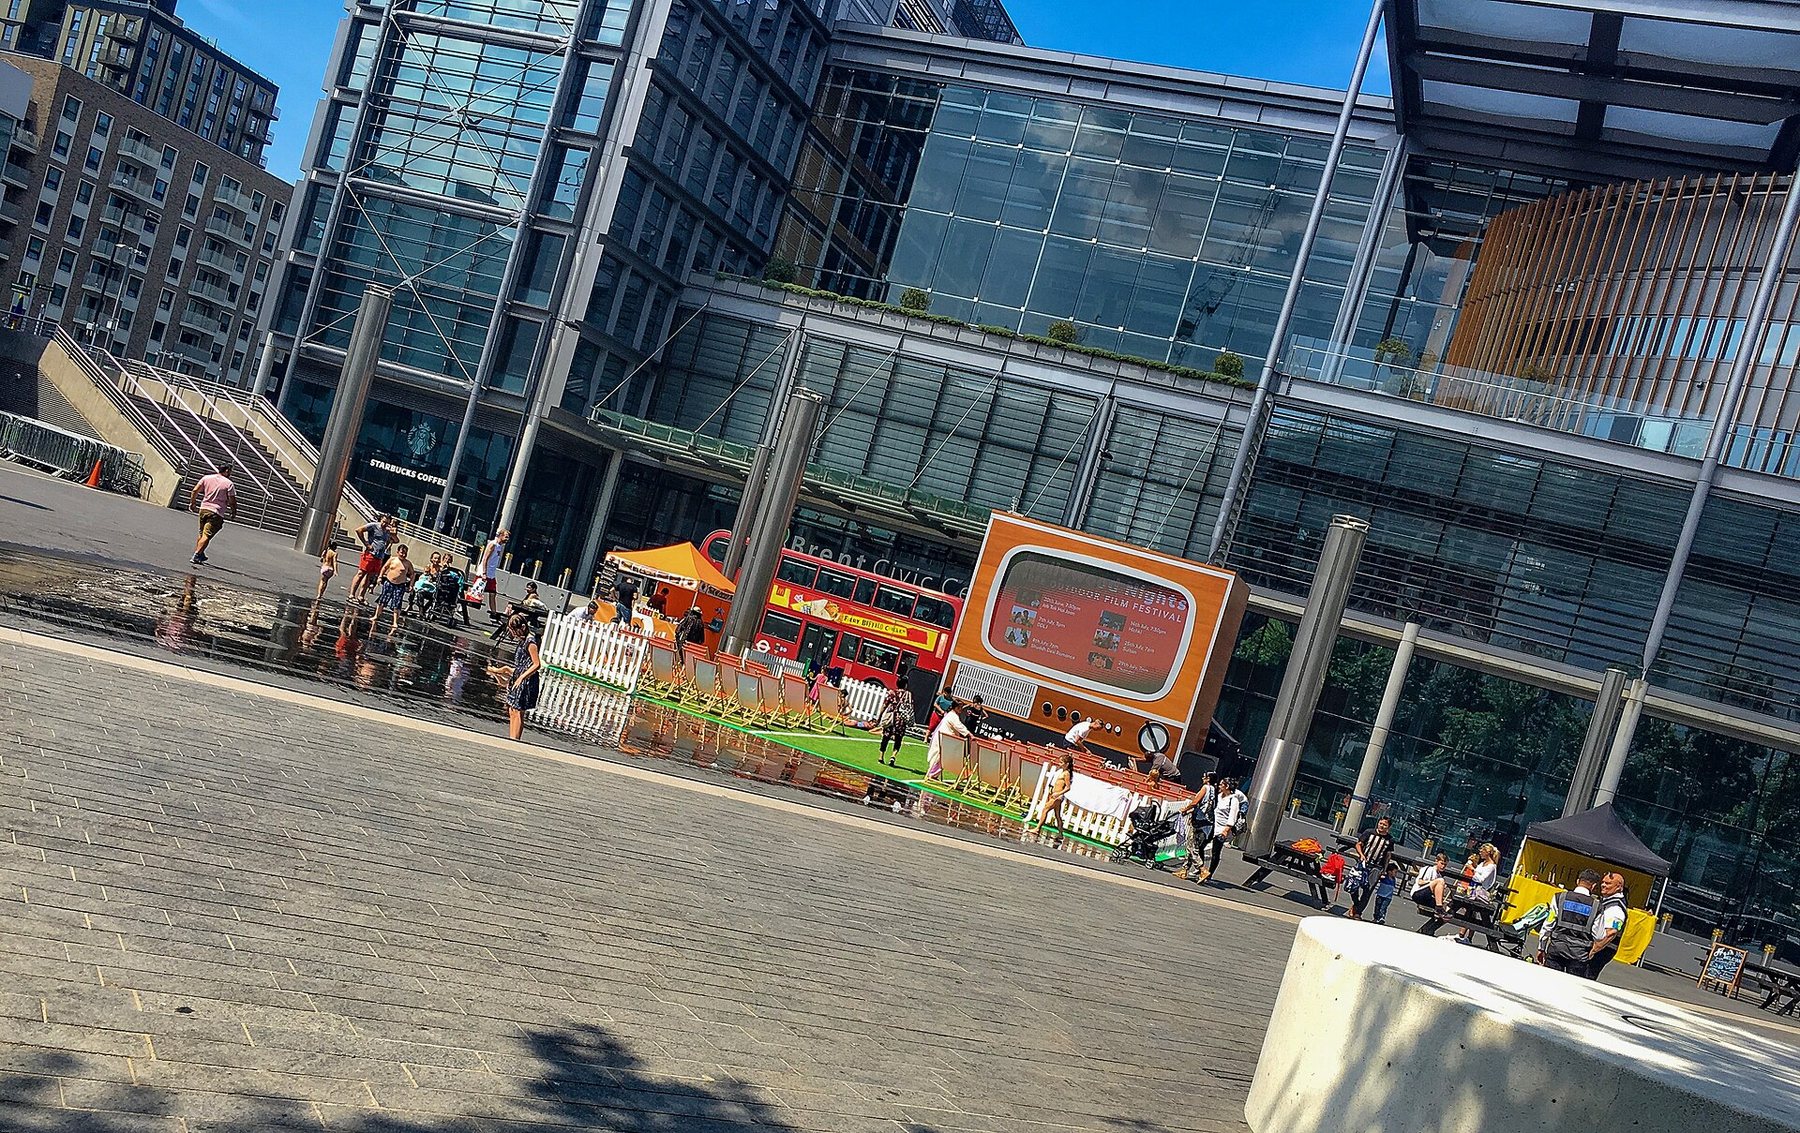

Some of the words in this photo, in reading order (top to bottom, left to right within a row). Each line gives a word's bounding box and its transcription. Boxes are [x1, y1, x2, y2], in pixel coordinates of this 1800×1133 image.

[370, 459, 416, 478] STARBUCKS
[417, 472, 448, 487] COFFEE
[791, 535, 867, 569] Brent
[873, 558, 933, 589] Civic
[1104, 595, 1129, 608] FILM
[1132, 604, 1182, 623] FESTIVAL
[981, 722, 1015, 738] Wemey
